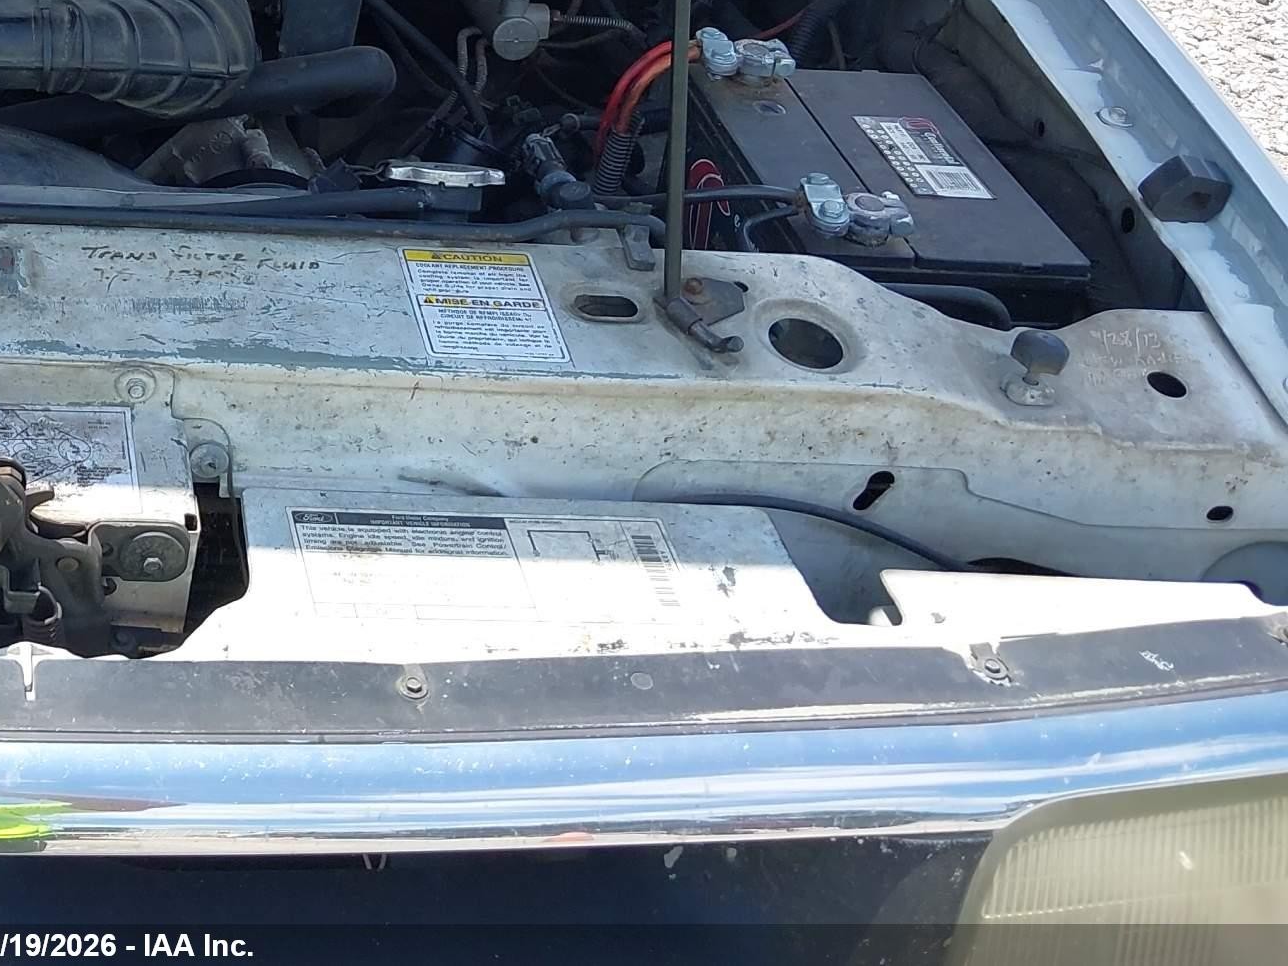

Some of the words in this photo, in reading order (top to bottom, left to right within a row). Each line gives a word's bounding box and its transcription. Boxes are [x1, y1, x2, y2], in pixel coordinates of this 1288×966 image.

[442, 254, 502, 262] CAUTION
[436, 298, 470, 306] MISE
[493, 300, 542, 308] GARDE
[302, 513, 325, 522] Ford
